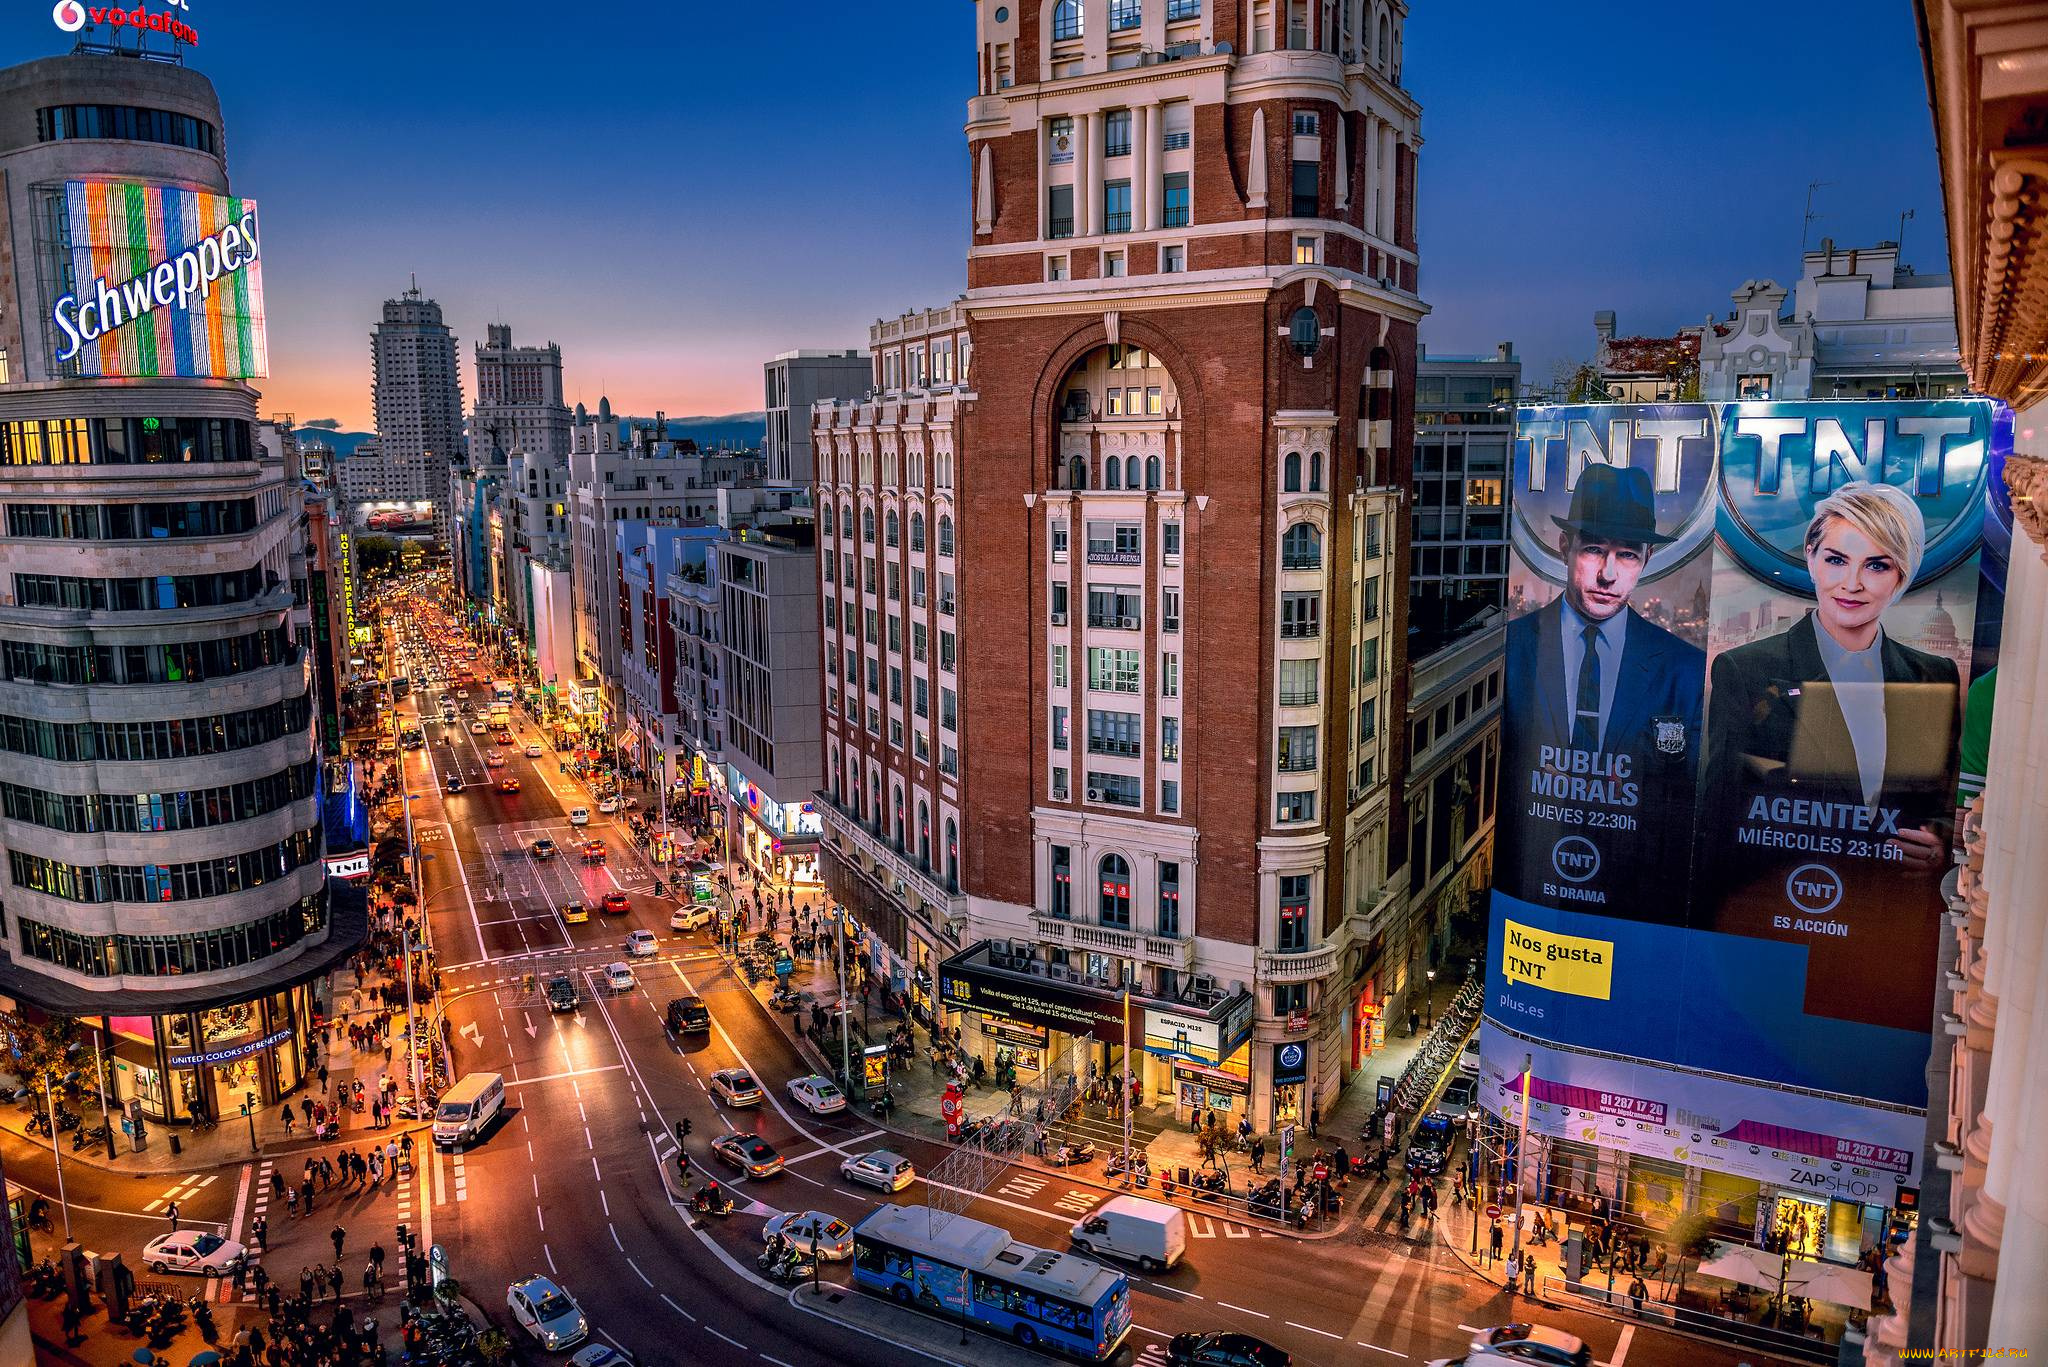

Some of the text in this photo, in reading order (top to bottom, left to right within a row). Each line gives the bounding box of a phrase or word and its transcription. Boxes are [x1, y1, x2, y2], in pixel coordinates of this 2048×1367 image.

[89, 5, 198, 46] vodafone
[54, 211, 258, 362] Schweppes
[1516, 418, 1707, 495] TNT
[1734, 417, 1975, 496] TNT
[340, 533, 351, 574] HOTEL
[1120, 554, 1140, 562] PRENSA
[315, 574, 329, 641] HOTEL
[344, 577, 357, 647] EMPERADOR
[326, 714, 339, 751] REX
[1540, 744, 1631, 778] PUBLIC
[1531, 770, 1639, 807] MORALS
[1528, 802, 1637, 831] JUEVES 22:30h
[1748, 795, 1900, 835] AGENTE X
[1738, 826, 1903, 860] MIÉRCOLES 23:15h
[1559, 851, 1594, 868] TNT
[1543, 883, 1606, 903] ES DRAMA
[1794, 881, 1836, 898] TNT
[1773, 915, 1848, 936] ES ACCIÓN
[1510, 930, 1602, 964] Nos gusta
[1508, 956, 1546, 980] TNT
[1001, 993, 1020, 1003] espacio
[1054, 1003, 1071, 1012] centro
[1072, 1006, 1093, 1017] cultural
[1093, 1012, 1111, 1021] Conde
[1012, 1001, 1020, 1009] del
[1500, 994, 1545, 1018] plus.es
[1160, 1018, 1202, 1032] ESPACIO M125
[172, 1055, 203, 1064] UNITED
[205, 1048, 241, 1061] COLORS
[244, 1044, 256, 1053] OF
[1600, 1093, 1664, 1116] 91 287 17 20
[1836, 1140, 1909, 1164] 91 287 17 20
[997, 1174, 1050, 1199] TAXI
[1790, 1168, 1878, 1198] ZAPSHOP
[1053, 1190, 1101, 1214] BUS
